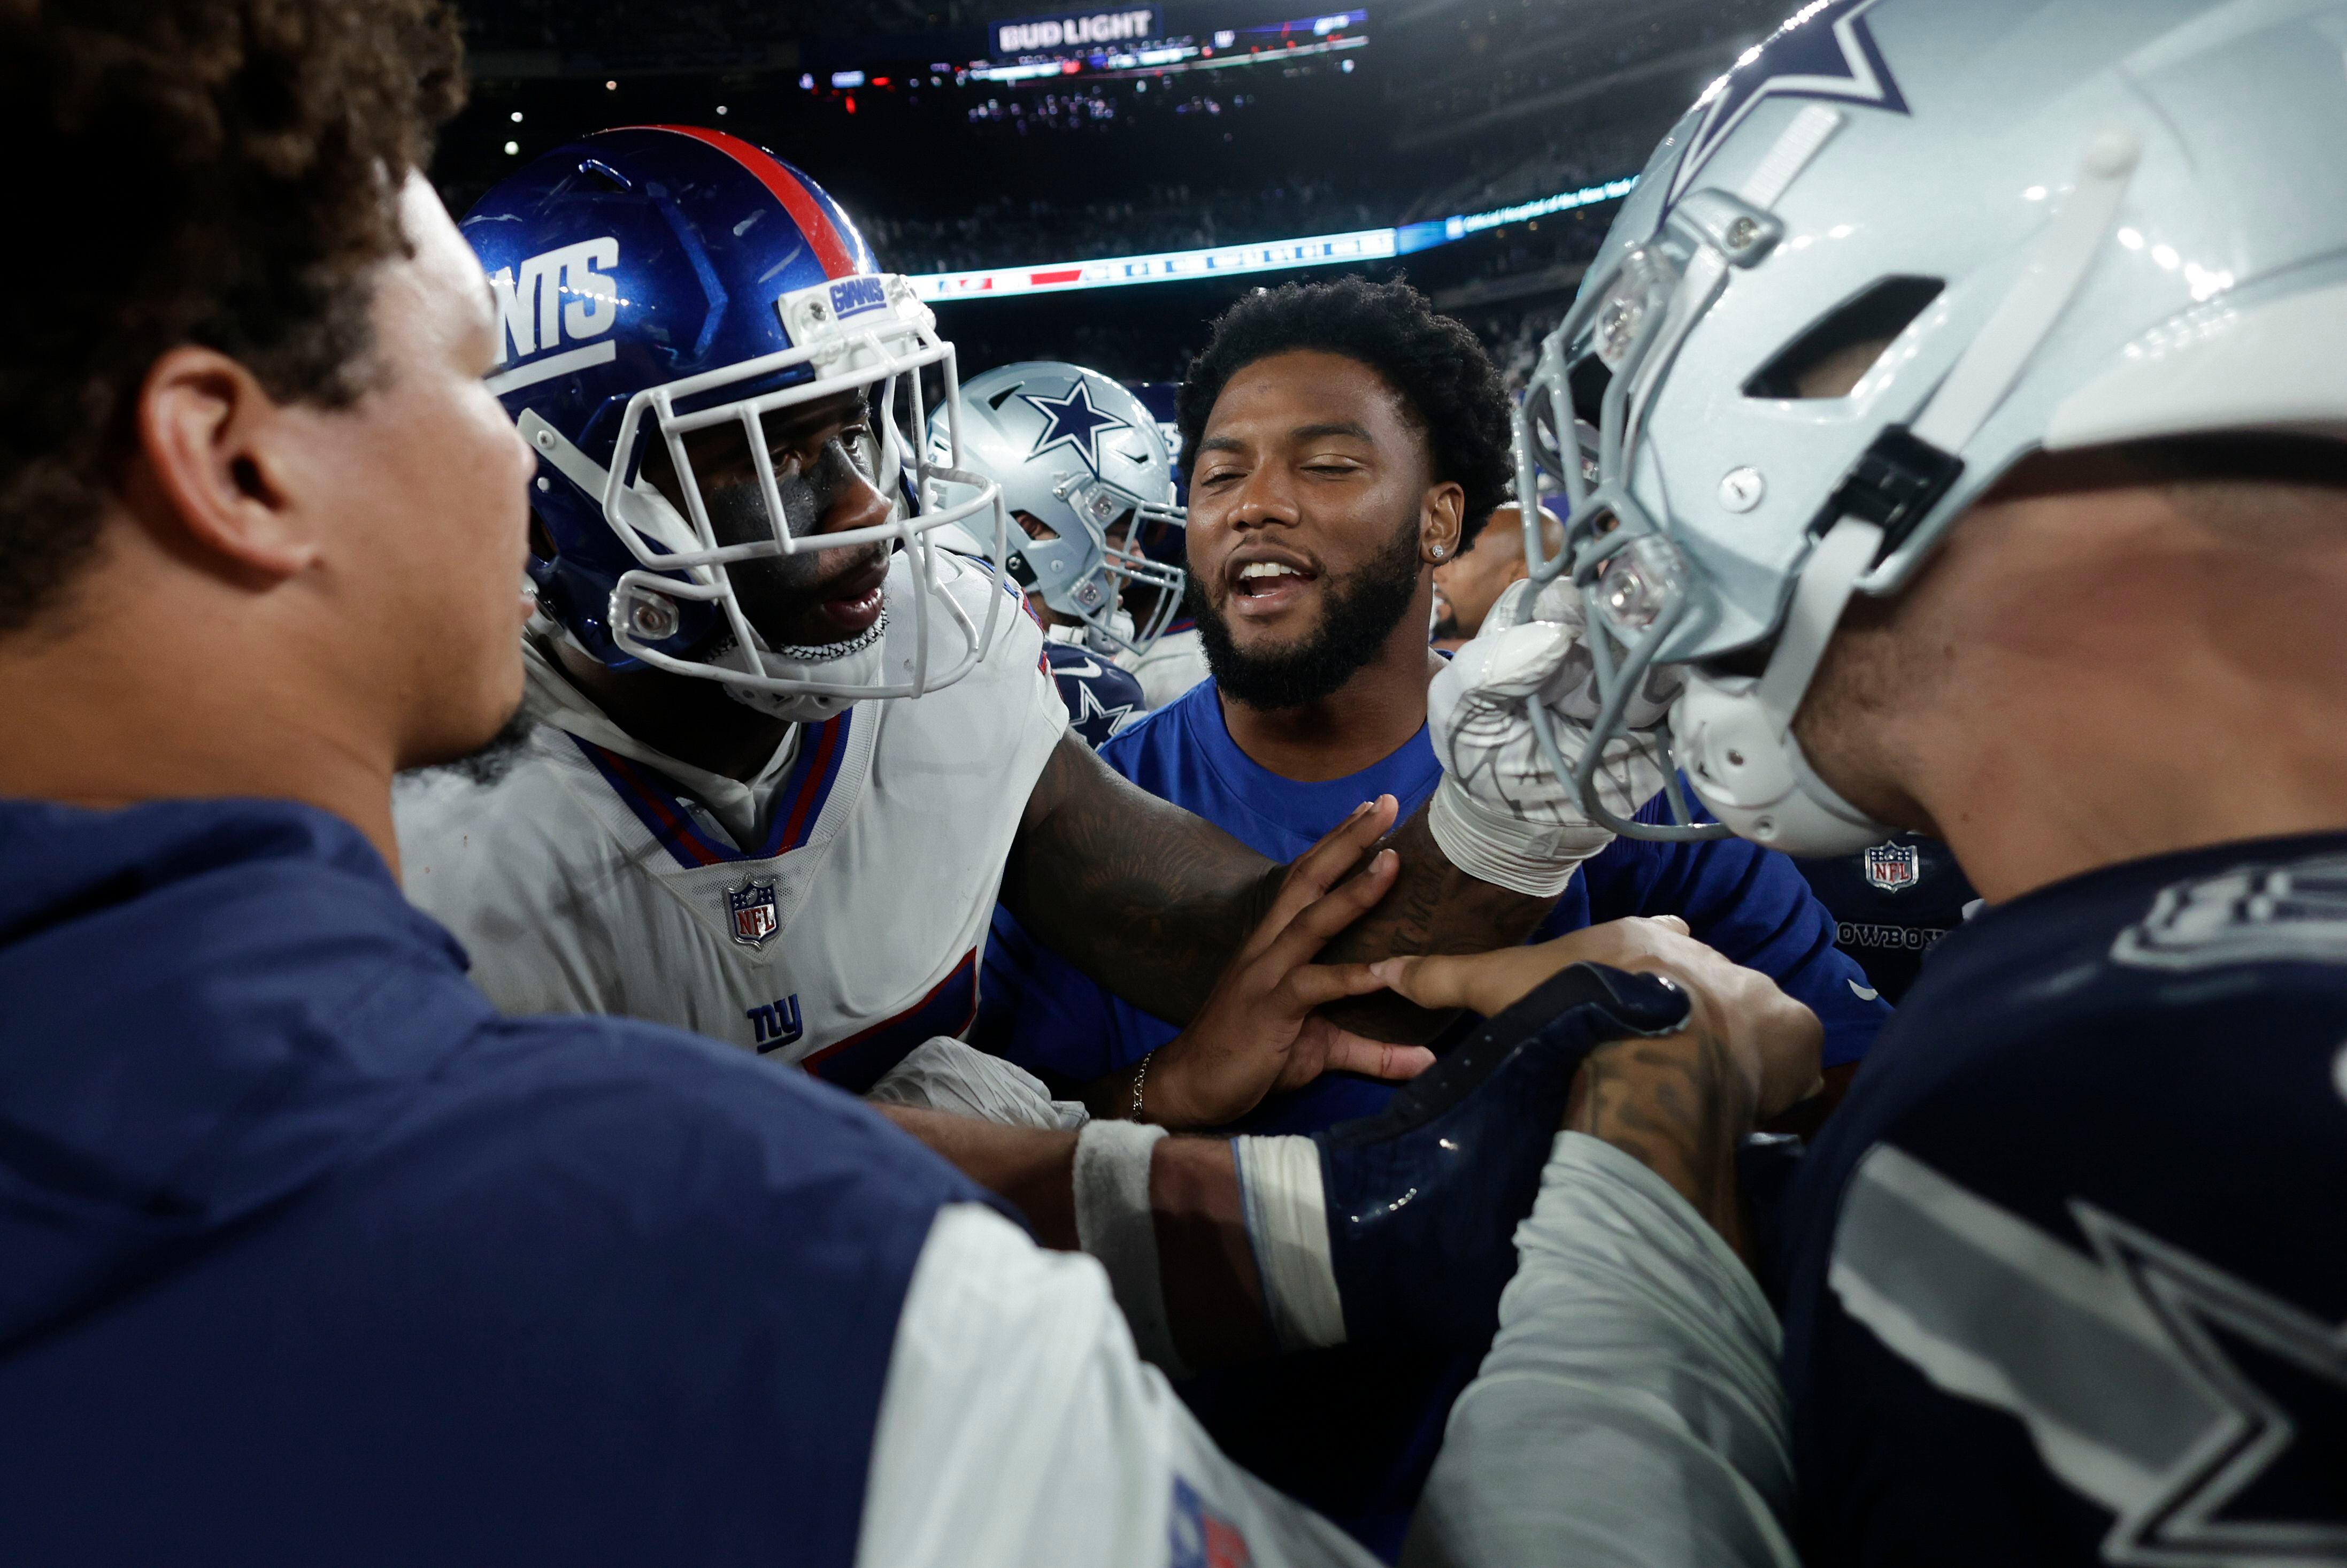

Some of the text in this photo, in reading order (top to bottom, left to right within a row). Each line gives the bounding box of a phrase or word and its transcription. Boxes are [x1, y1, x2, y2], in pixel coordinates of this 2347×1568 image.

[999, 9, 1153, 52] BUD LIGHT
[493, 236, 619, 363] NTS
[829, 277, 884, 312] GIANTS
[1875, 862, 1909, 882] NFL
[737, 906, 775, 936] NFL
[1837, 921, 1951, 950] OWBOY
